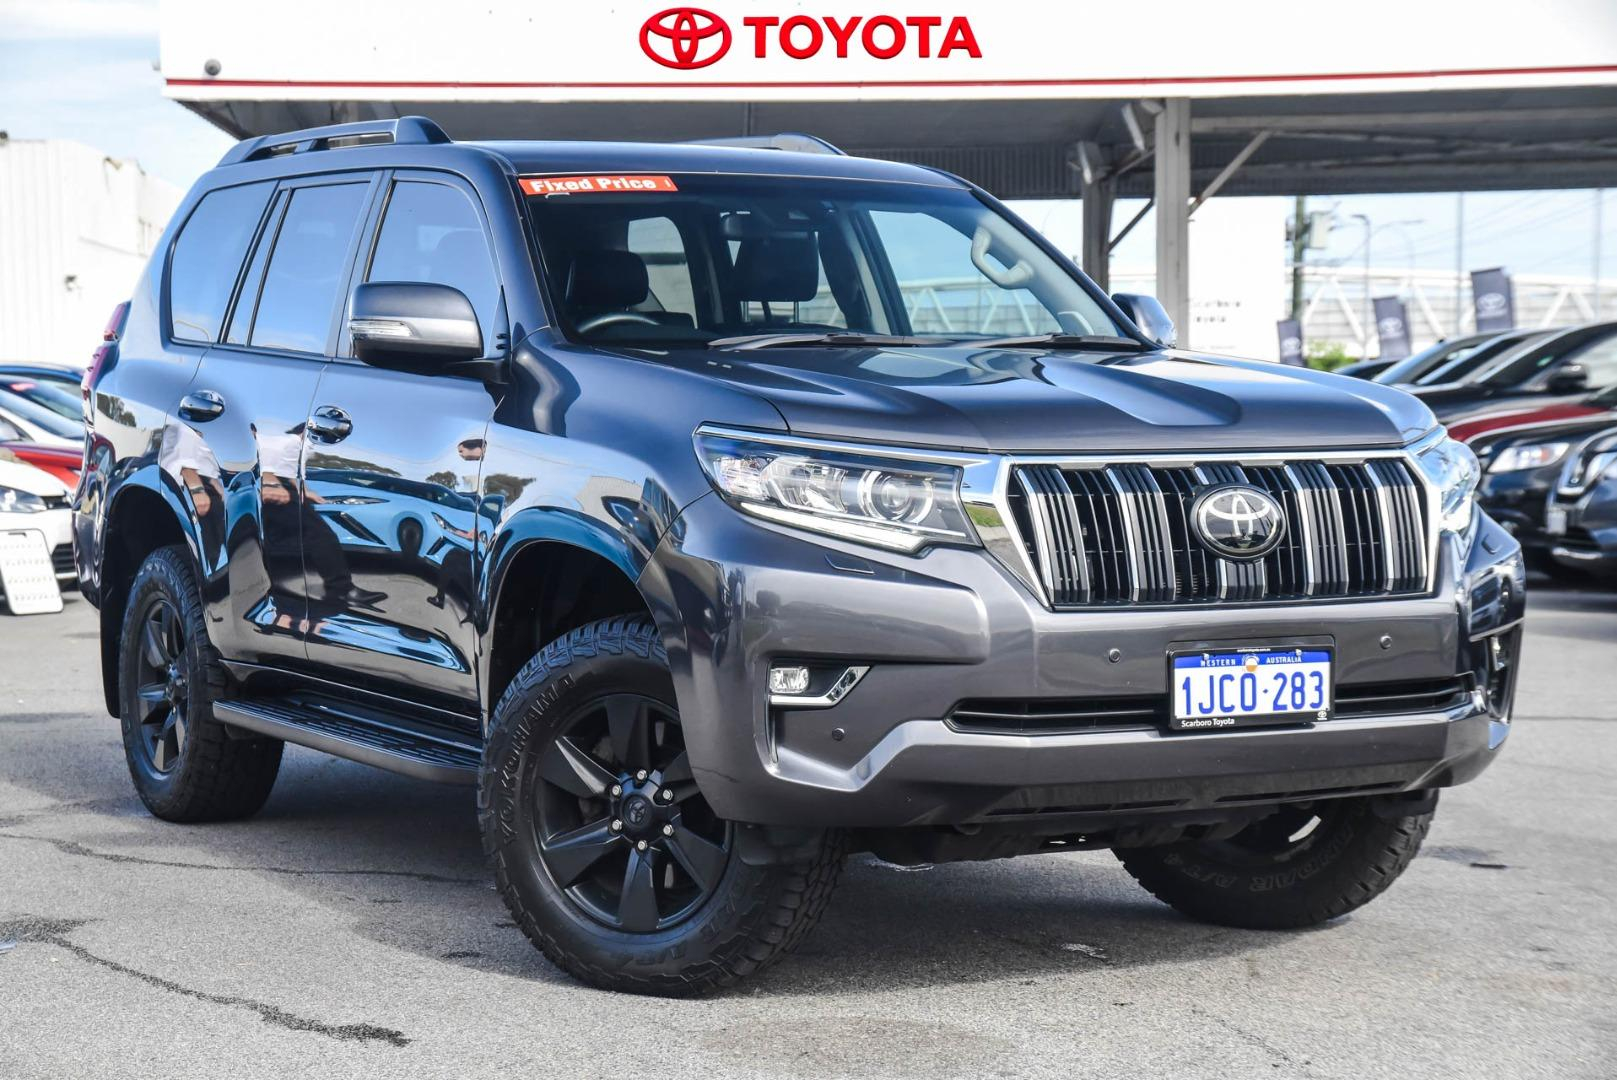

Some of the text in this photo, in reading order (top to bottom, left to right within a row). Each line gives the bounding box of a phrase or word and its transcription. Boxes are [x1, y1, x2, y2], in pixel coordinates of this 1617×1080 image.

[743, 15, 982, 59] TOYOTA
[529, 177, 656, 192] Fixed Price
[1200, 655, 1302, 667] WESTERN AUSTRALIA
[1181, 717, 1235, 728] Scarboro Toyota
